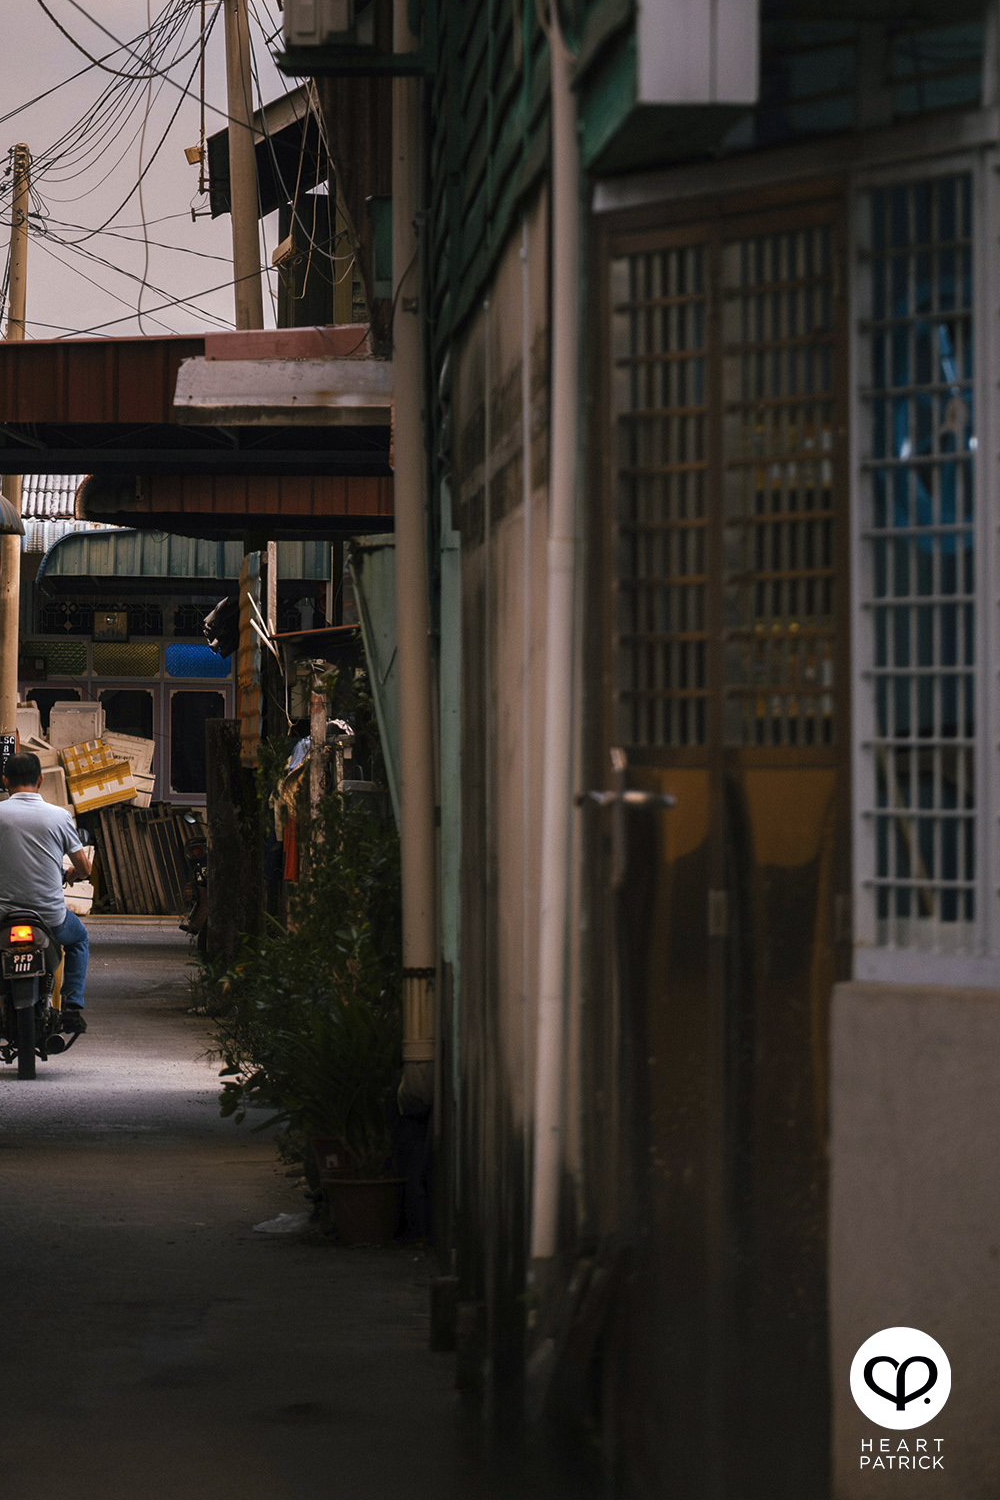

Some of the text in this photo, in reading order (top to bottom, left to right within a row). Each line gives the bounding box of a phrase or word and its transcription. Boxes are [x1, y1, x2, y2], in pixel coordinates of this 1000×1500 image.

[3, 745, 10, 753] 8
[13, 953, 34, 963] PFD
[15, 962, 31, 972] 1111
